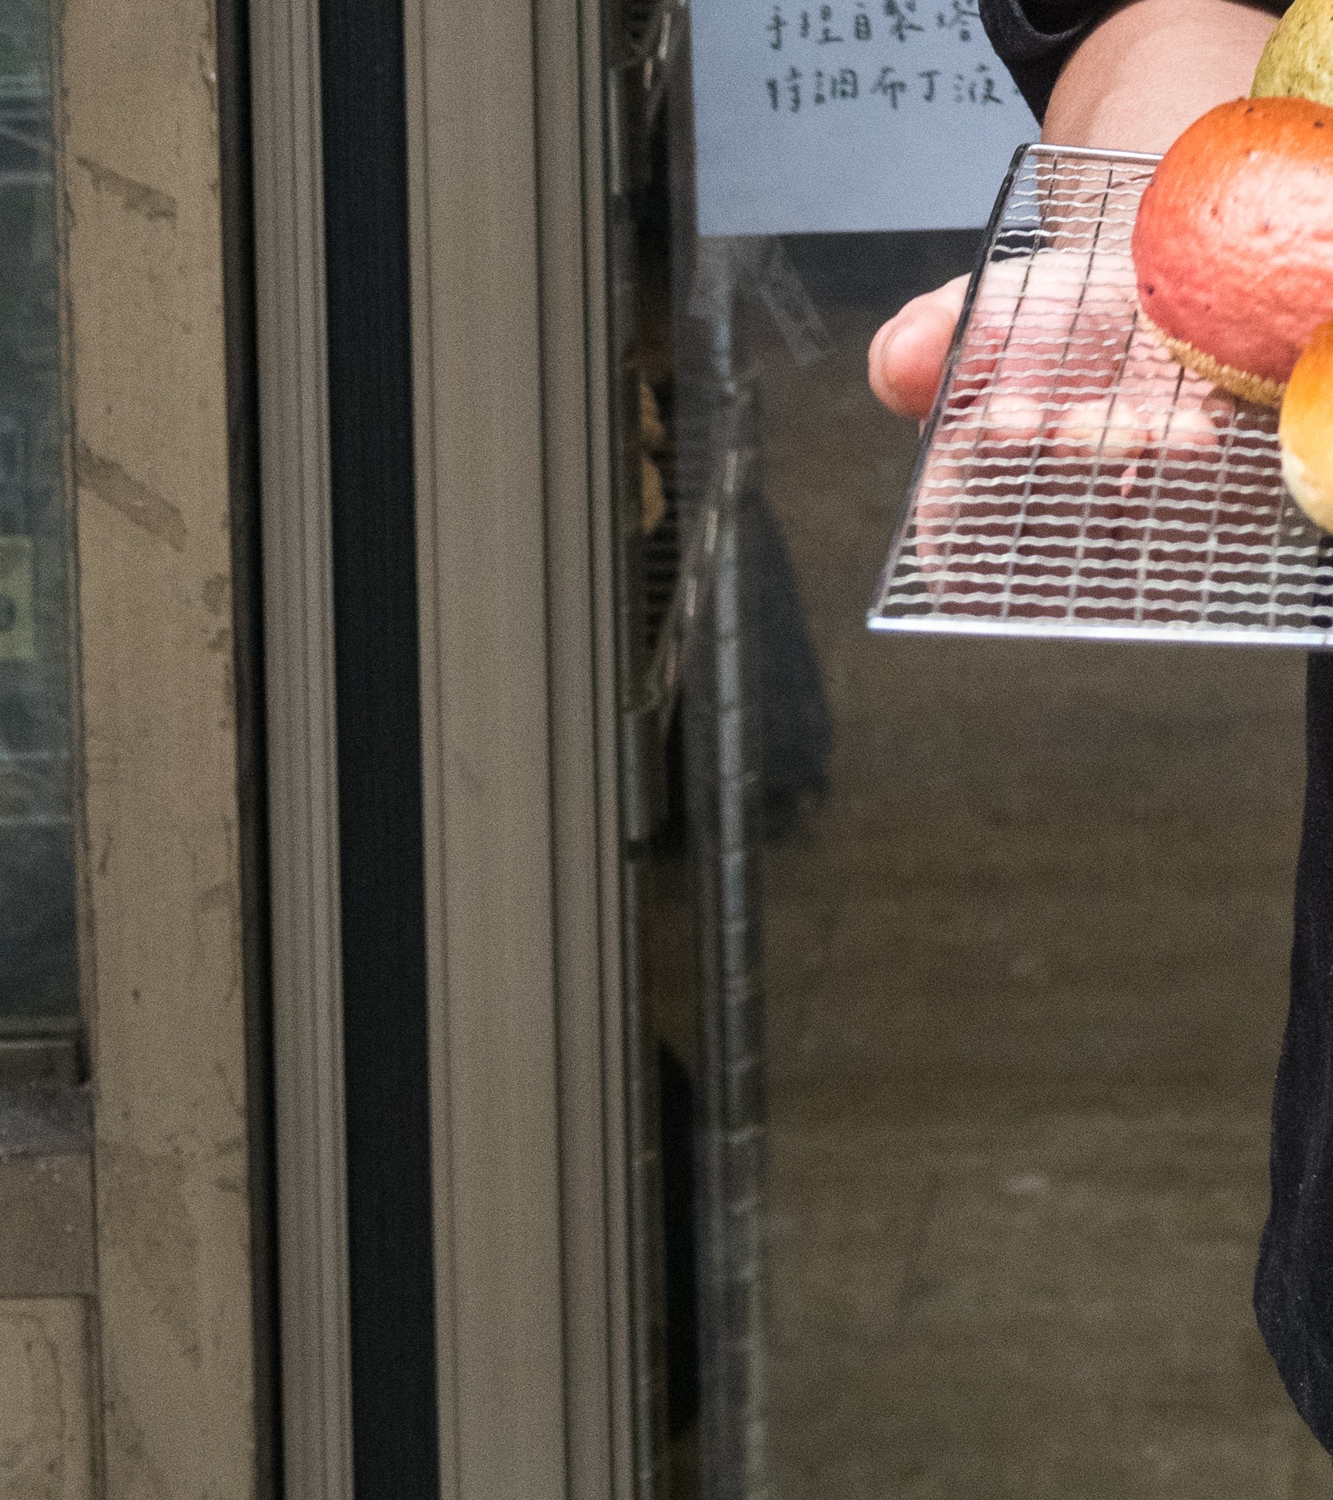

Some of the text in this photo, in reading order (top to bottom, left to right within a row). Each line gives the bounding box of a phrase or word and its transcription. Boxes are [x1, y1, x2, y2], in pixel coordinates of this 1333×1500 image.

[764, 61, 1021, 114] 特調布丁液
